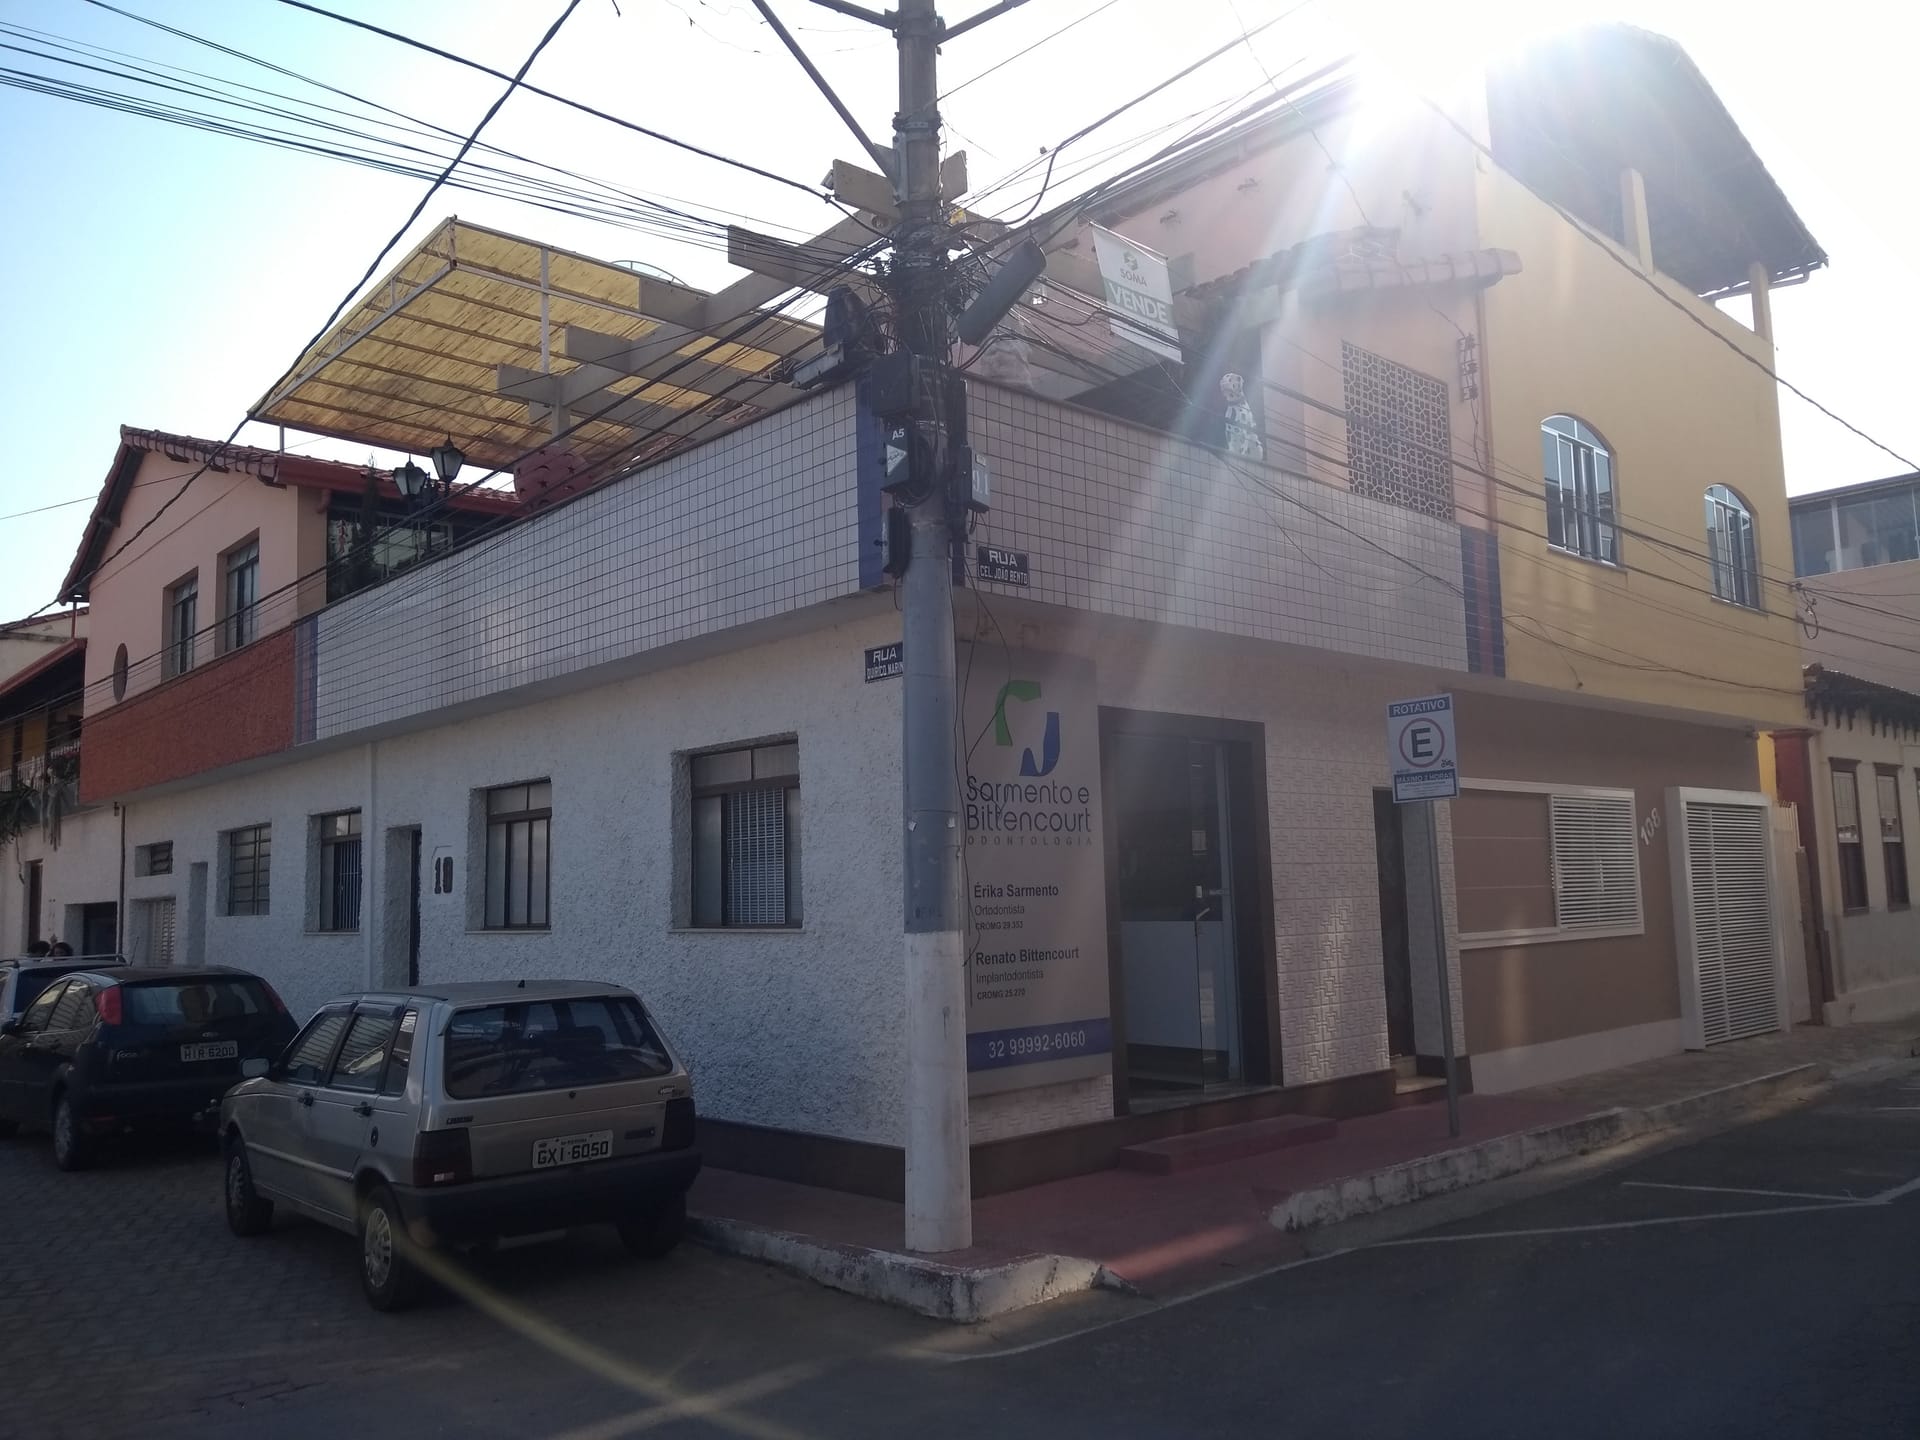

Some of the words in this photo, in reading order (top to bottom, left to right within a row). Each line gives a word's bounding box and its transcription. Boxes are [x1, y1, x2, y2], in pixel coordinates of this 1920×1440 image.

[1120, 269, 1147, 287] SOMA
[1109, 282, 1169, 324] VENDE
[892, 428, 905, 441] A5
[989, 550, 1018, 567] RUA
[1009, 570, 1028, 585] BENTO
[873, 647, 897, 663] RUA
[1393, 699, 1446, 715] ROTATIVO
[1411, 727, 1433, 758] E
[966, 775, 1073, 805] Sarmento
[1078, 786, 1090, 805] e
[966, 804, 1091, 832] Bittencourt
[1640, 807, 1661, 846] 108
[967, 835, 1092, 846] ODONTOLOGIA
[974, 882, 1004, 898] Érika
[1006, 883, 1059, 897] Sarmento
[975, 904, 1025, 916] Ortodontista
[976, 952, 1017, 966] Renato
[1019, 948, 1080, 963] Bittencourt
[976, 968, 1044, 985] Implantodontista
[977, 989, 1004, 1000] CROMG
[988, 1040, 1005, 1059] 32
[1010, 1030, 1086, 1056] 99992-6060
